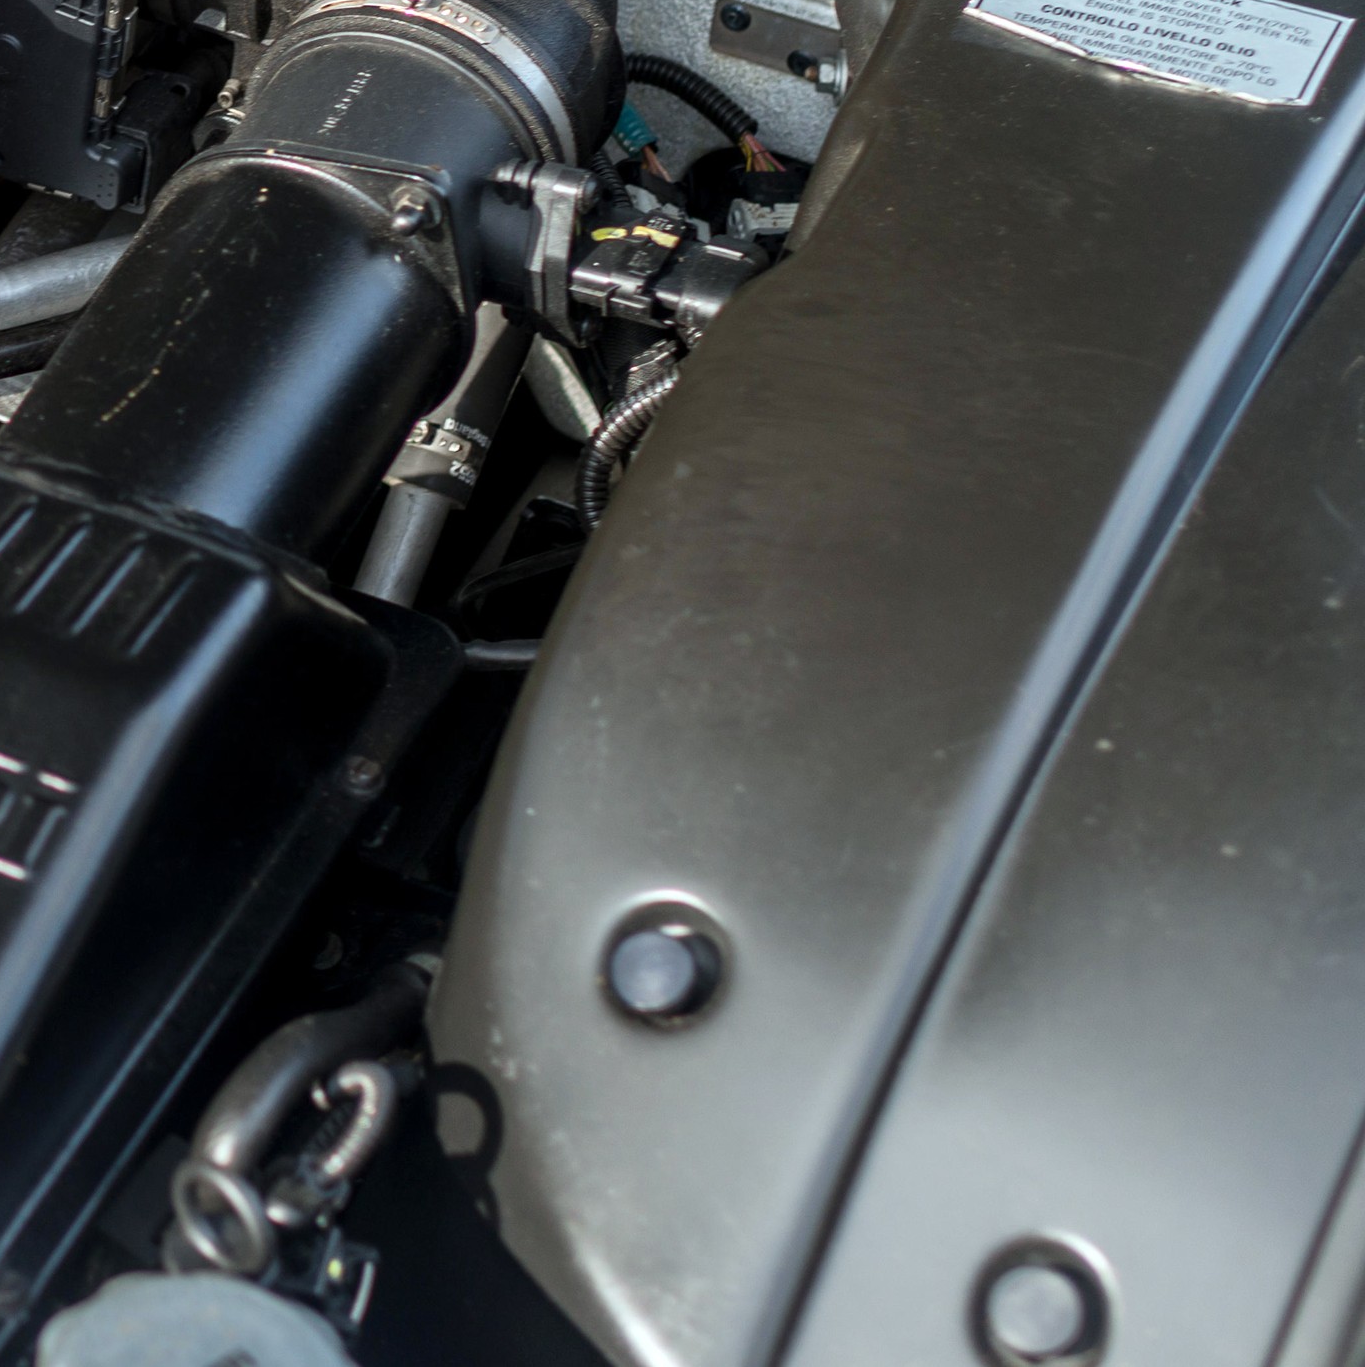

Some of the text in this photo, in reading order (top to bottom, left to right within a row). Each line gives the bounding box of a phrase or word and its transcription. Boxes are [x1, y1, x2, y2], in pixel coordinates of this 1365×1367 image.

[1040, 4, 1257, 57] CONTROLLO LIVELLO OLIO
[1138, 0, 1233, 27] IMMEDIATELY
[1234, 21, 1281, 40] AFTER
[1286, 33, 1313, 47] THE
[1140, 11, 1156, 20] IS
[1158, 14, 1225, 36] STOPPED
[1183, 0, 1223, 15] OVER
[1013, 12, 1117, 40] TEMPERATURA
[1119, 34, 1153, 48] OLIO
[1156, 42, 1219, 63] MOTORE
[1082, 36, 1209, 72] IMMEDIATAMENTE
[1212, 64, 1255, 82] DOPO
[1257, 75, 1277, 87] LO
[1167, 65, 1229, 88] MOTORE
